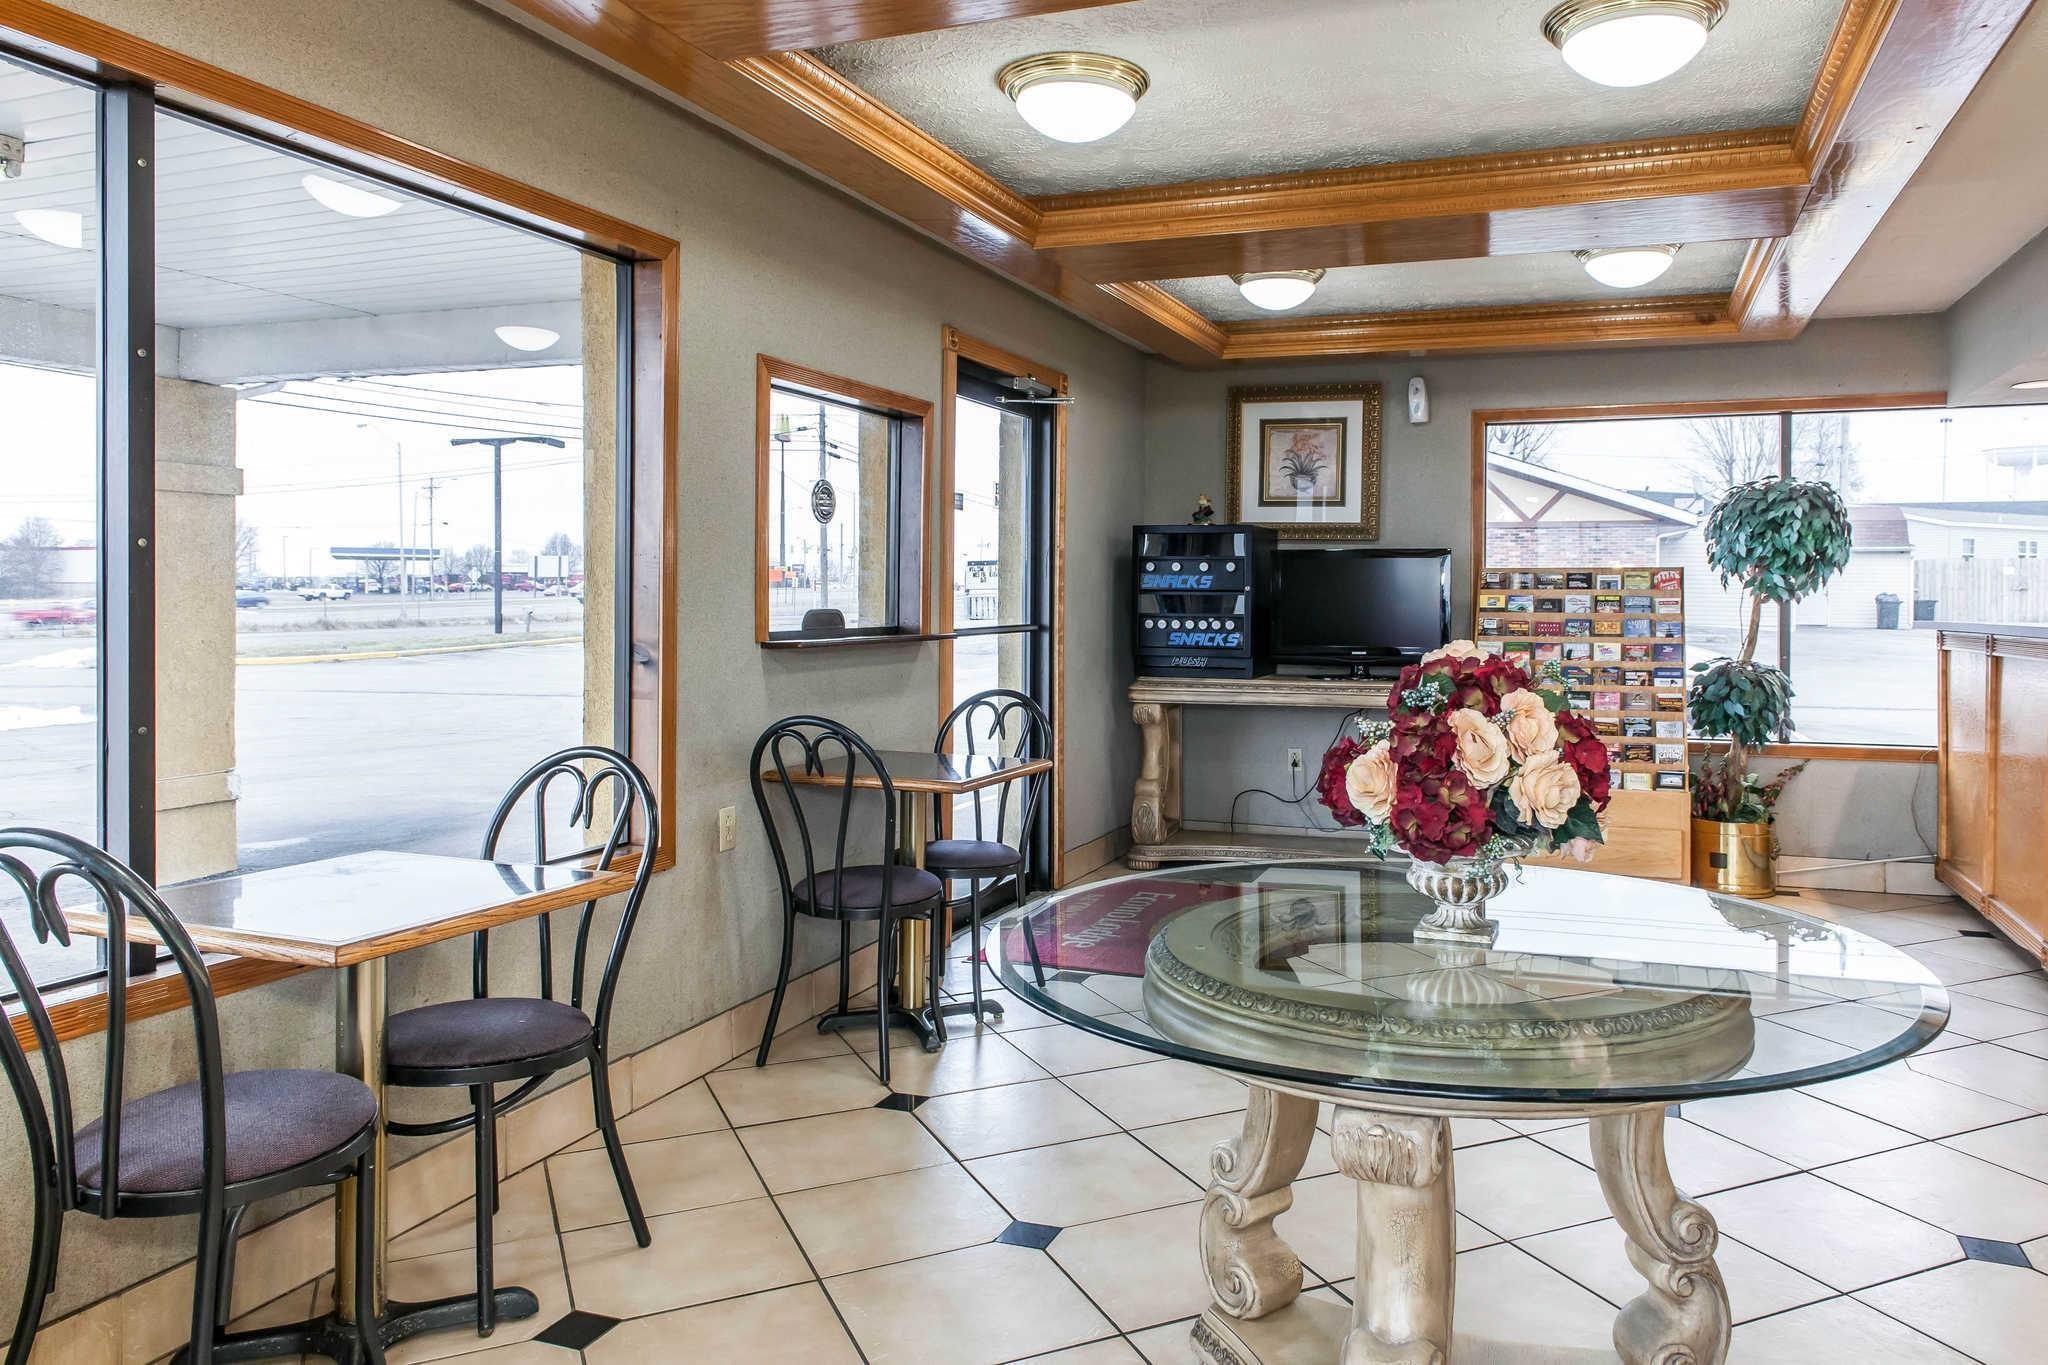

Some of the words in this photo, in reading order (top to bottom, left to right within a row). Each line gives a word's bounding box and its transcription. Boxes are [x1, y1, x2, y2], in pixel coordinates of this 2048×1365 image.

[1141, 574, 1214, 589] SNACKS
[1168, 632, 1241, 647] SNACKS
[1171, 656, 1208, 667] PUSH
